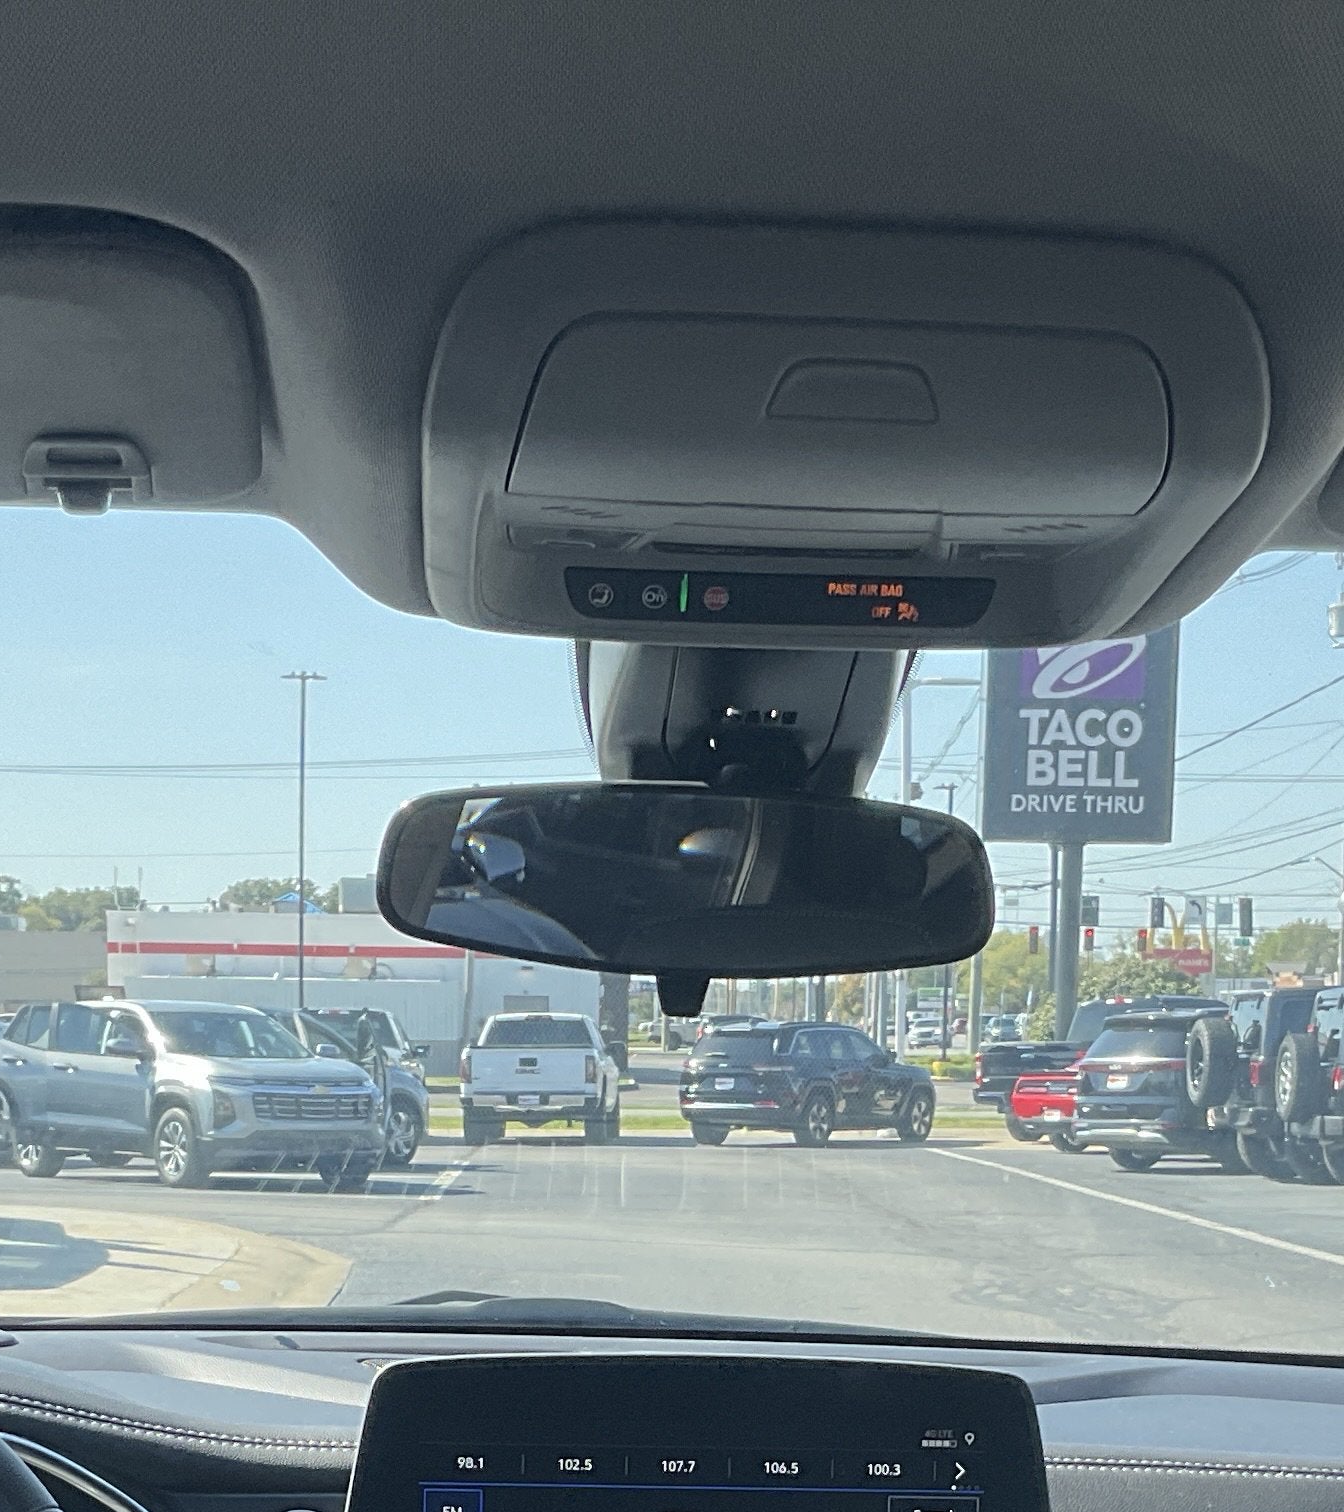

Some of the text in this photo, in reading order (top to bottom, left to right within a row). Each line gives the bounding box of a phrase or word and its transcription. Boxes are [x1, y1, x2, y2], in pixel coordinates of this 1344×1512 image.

[828, 582, 856, 596] PASS
[860, 584, 878, 596] AIR
[871, 606, 892, 618] OFF
[1019, 708, 1143, 747] TACO
[1026, 749, 1139, 788] BELL
[1010, 794, 1144, 814] DRIVE THRU
[457, 1457, 484, 1469] 98.1
[558, 1459, 593, 1471] 102.5
[661, 1460, 696, 1473] 107.7
[764, 1462, 799, 1475] 106.5
[867, 1463, 901, 1476] 100.3
